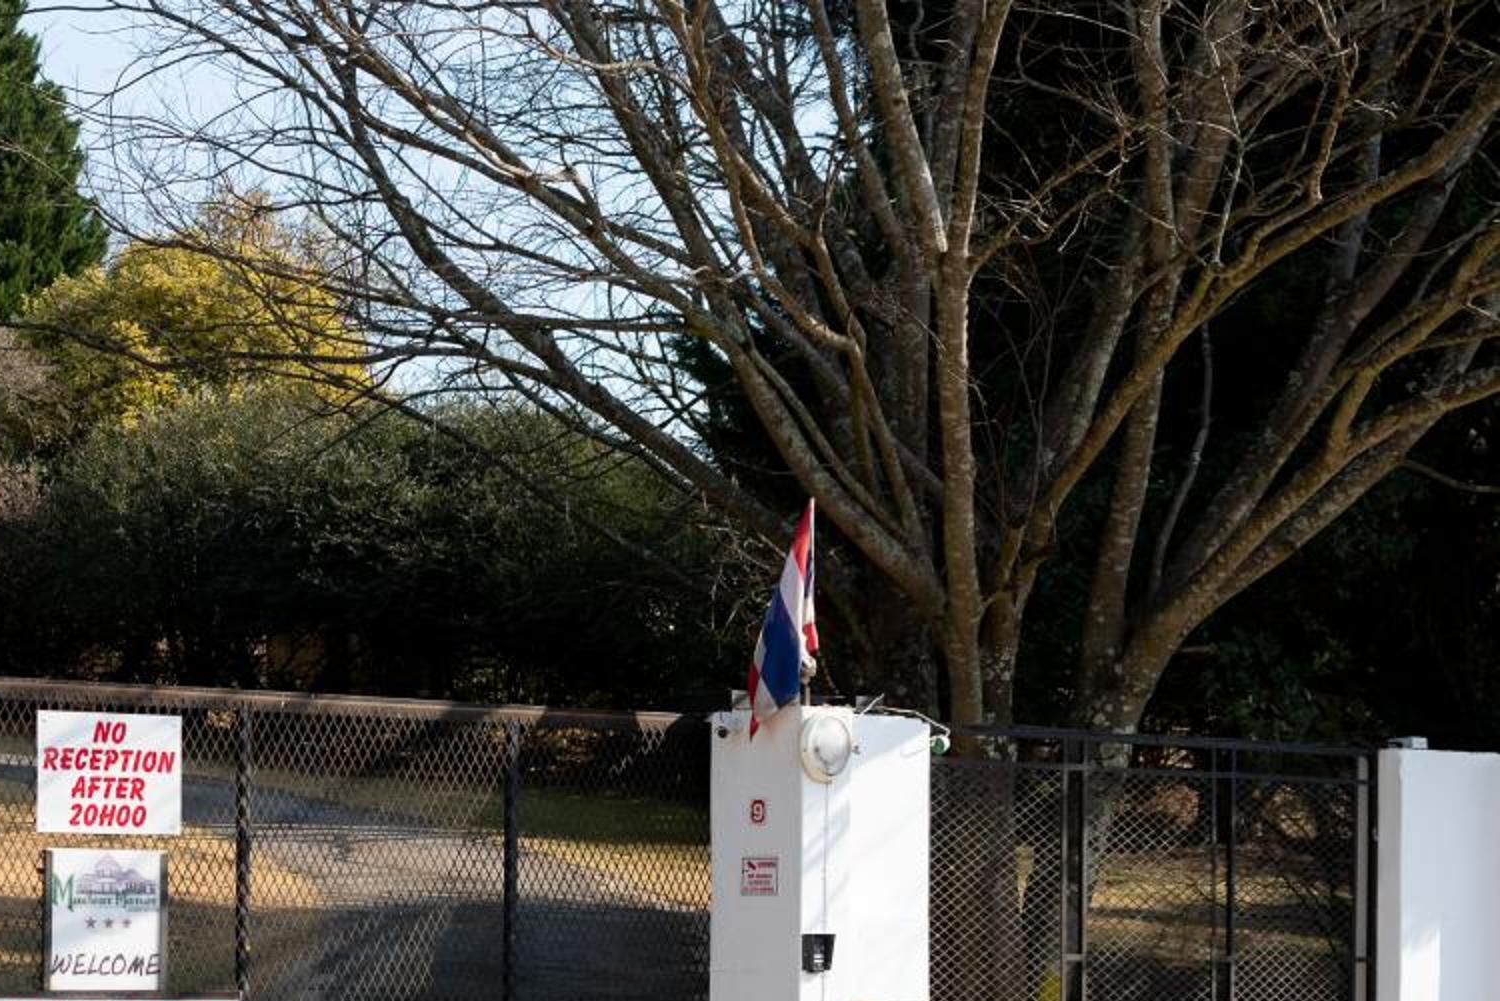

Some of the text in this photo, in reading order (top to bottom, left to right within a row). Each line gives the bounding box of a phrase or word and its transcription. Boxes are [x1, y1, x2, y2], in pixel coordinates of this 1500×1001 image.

[94, 721, 127, 744] NO
[43, 747, 176, 773] RECEPTION
[71, 776, 146, 801] AFTER
[69, 803, 147, 827] 20H00
[752, 800, 765, 822] 9
[51, 953, 161, 976] WELCOME
